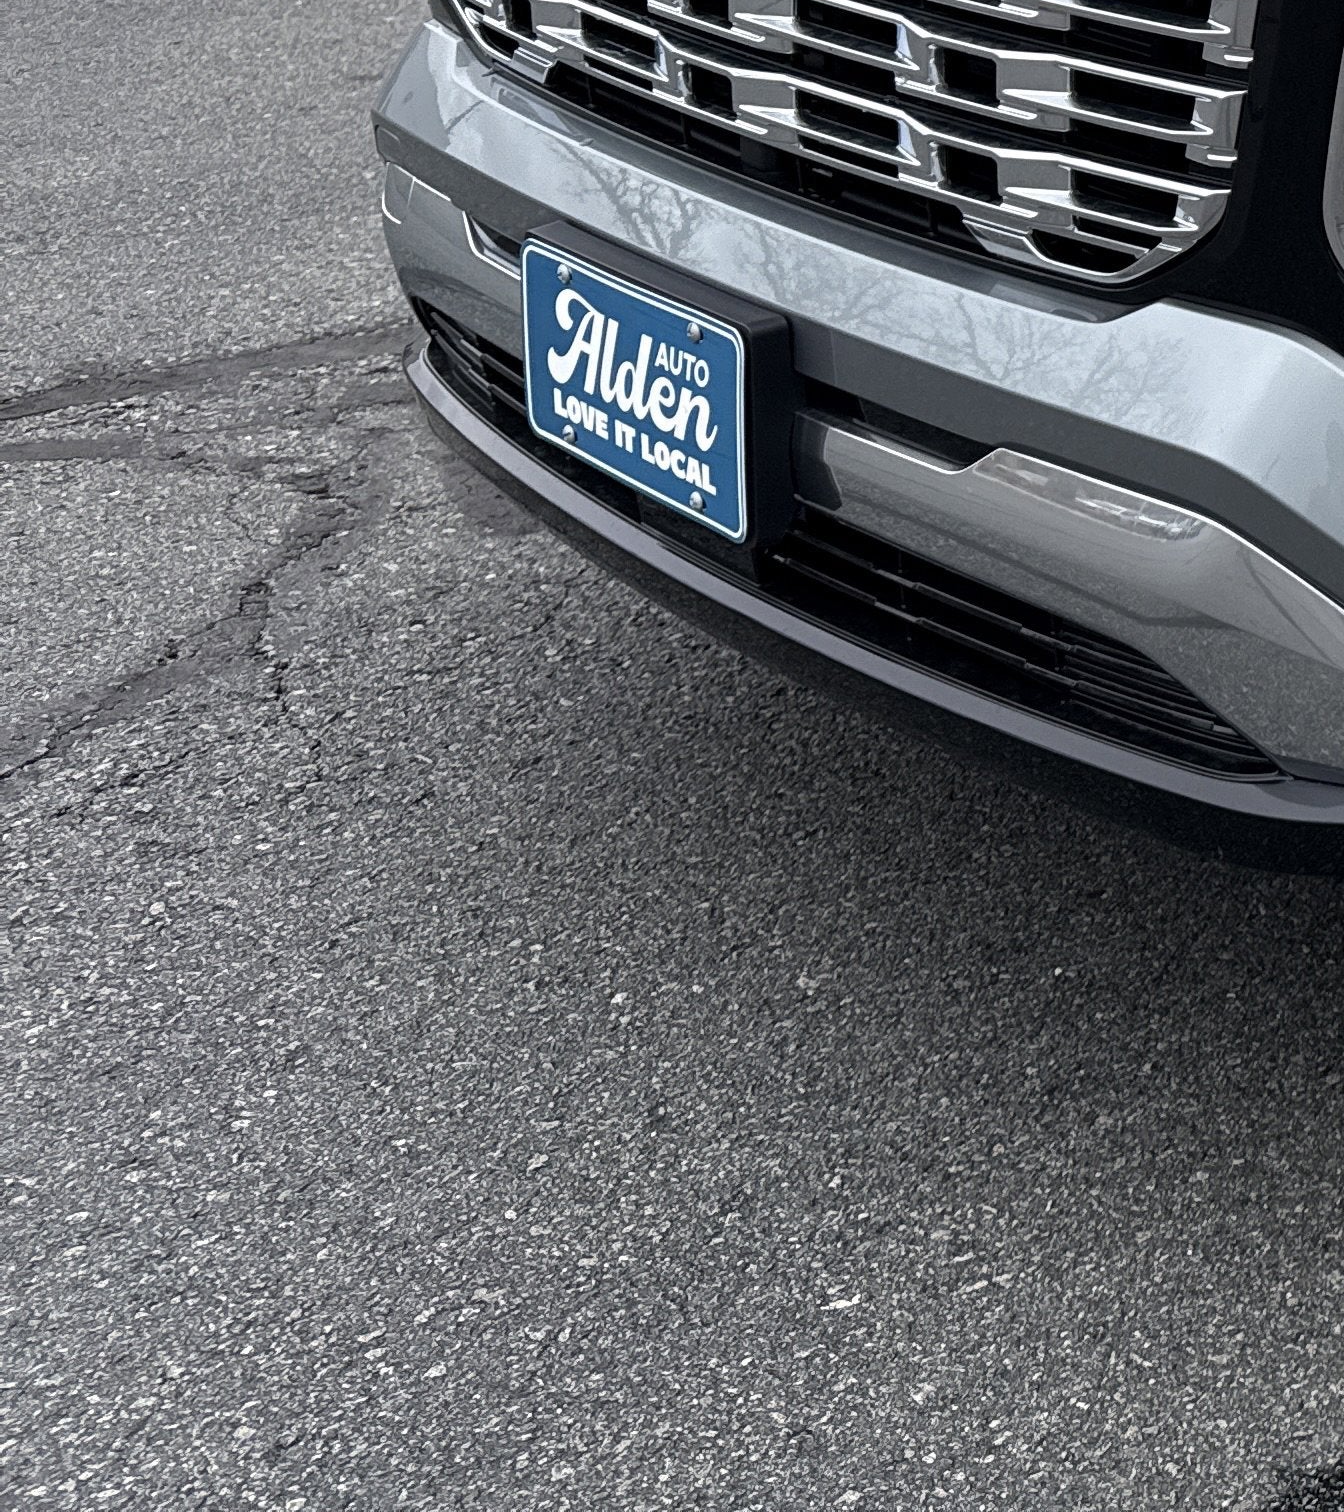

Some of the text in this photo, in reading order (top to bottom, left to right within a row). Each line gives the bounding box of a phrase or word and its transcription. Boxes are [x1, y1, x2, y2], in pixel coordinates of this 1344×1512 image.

[547, 288, 718, 451] Alden
[654, 342, 710, 388] AUTO
[553, 388, 717, 496] LOVE IT LOCAL
